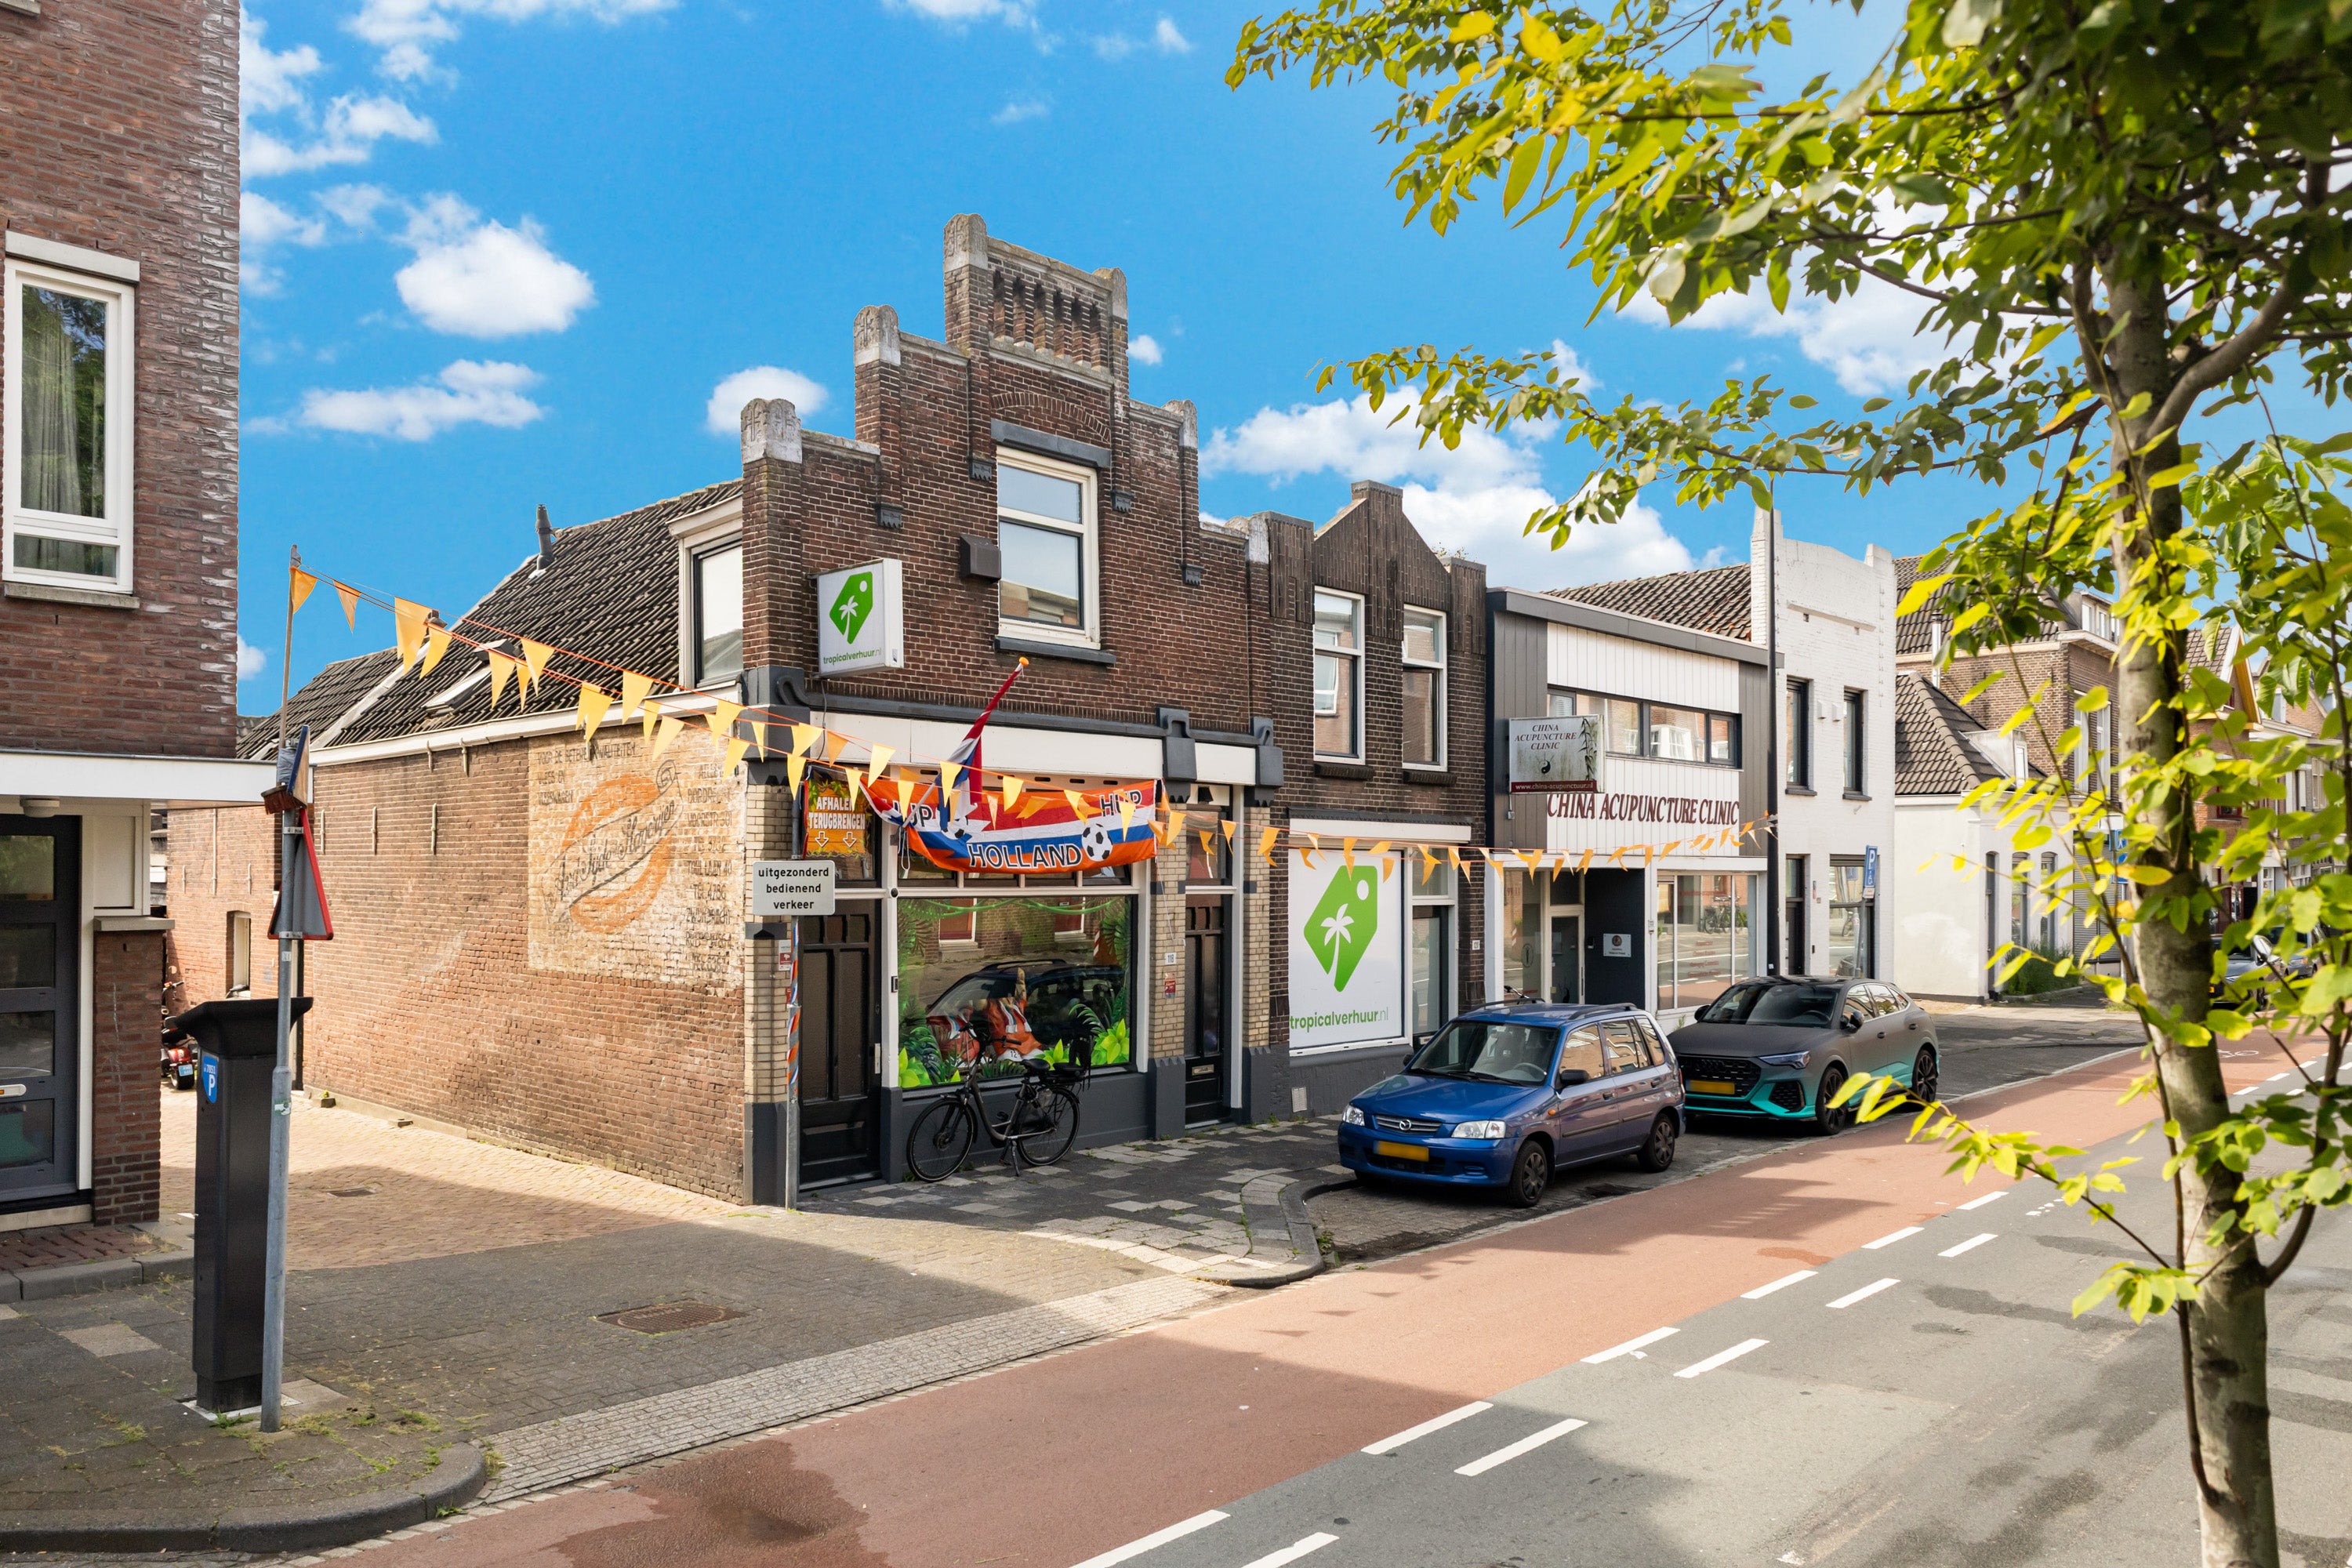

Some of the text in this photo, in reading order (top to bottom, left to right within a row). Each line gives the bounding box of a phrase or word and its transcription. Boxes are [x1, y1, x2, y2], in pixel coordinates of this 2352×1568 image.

[823, 648, 882, 666] tropicalverhuur.nl
[1532, 724, 1559, 732] CHINA
[1515, 732, 1577, 742] ACUPUNCTURE
[1530, 742, 1561, 750] CLINIC
[1515, 782, 1594, 791] www.china-acupunctuur.nl
[1547, 793, 1740, 826] CHINA ACUPUNCTURE CLINIC
[808, 812, 866, 829] TERUGBRENGEN
[969, 844, 1082, 868] HOLLAND
[1868, 849, 1875, 870] P
[758, 867, 829, 880] uitgezonderd
[766, 884, 822, 894] bedienend
[773, 899, 815, 909] verkeer
[1290, 1006, 1389, 1033] tropicalverhuur.nl
[208, 1074, 216, 1096] P
